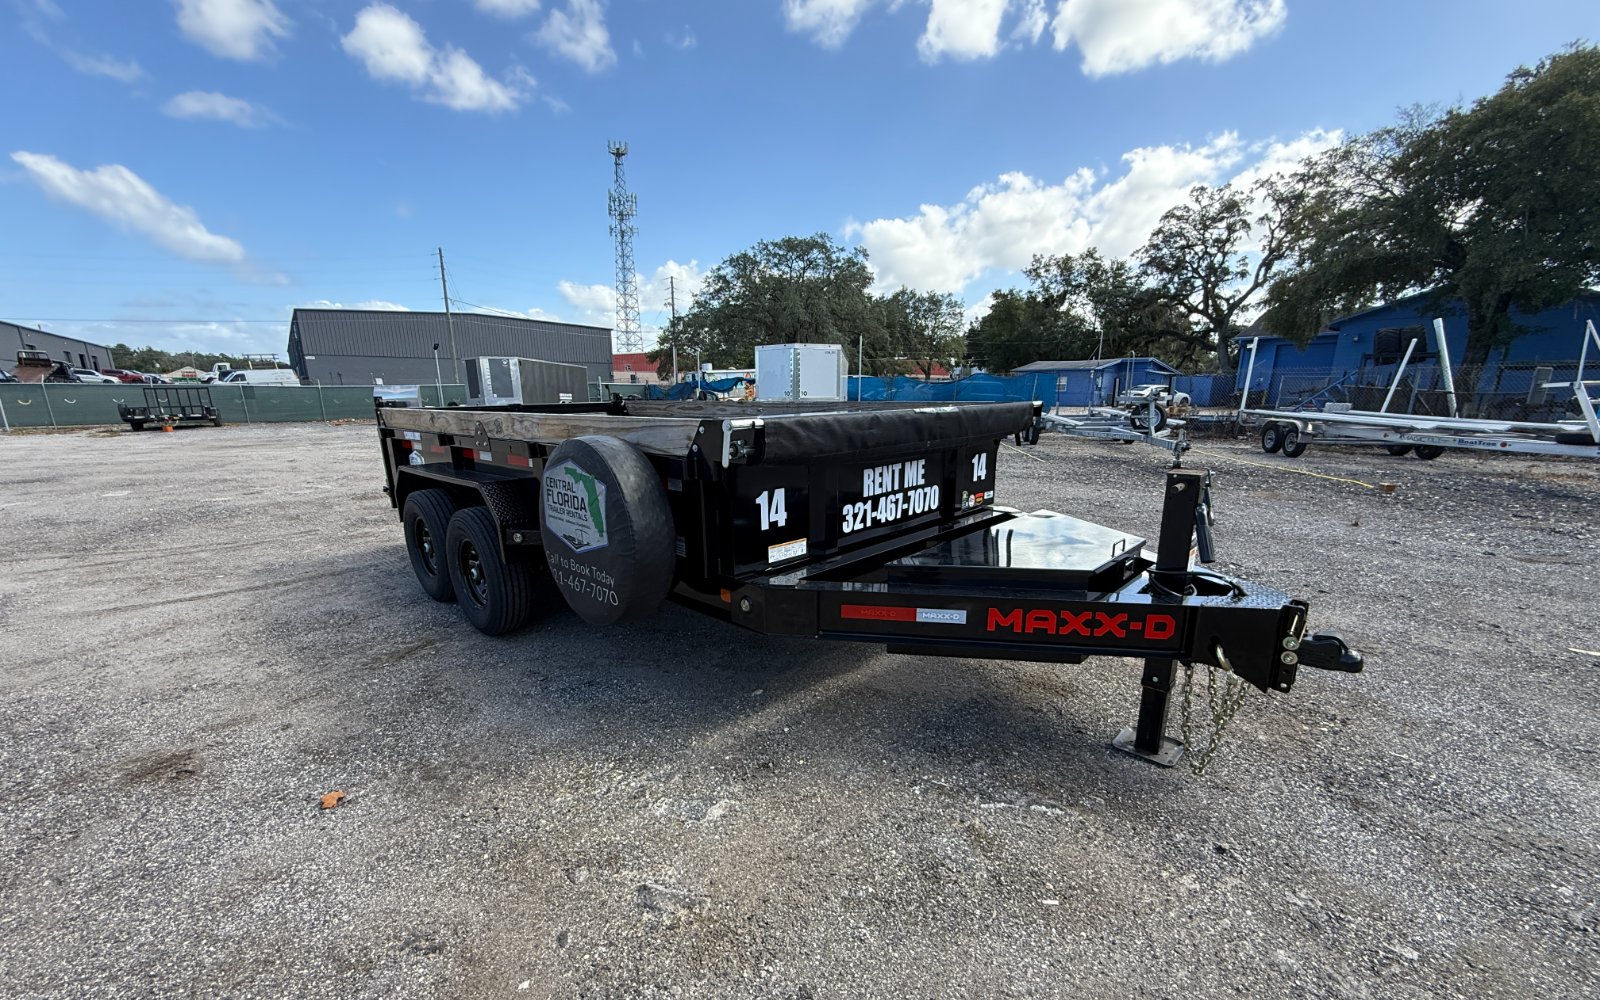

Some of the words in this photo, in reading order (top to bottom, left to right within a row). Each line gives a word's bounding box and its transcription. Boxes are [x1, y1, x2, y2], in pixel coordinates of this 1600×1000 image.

[863, 463, 902, 498] RENT
[904, 459, 926, 489] ME
[971, 452, 987, 482] 14
[546, 476, 576, 494] CENTRAL
[546, 489, 588, 514] FLORIDA
[547, 504, 566, 516] TRAILER
[566, 509, 588, 522] RENTALS
[755, 488, 788, 531] 14
[842, 485, 940, 534] 321-467-7070
[550, 567, 619, 606] 21-467-7070
[560, 556, 569, 569] to
[570, 559, 591, 577] Book
[591, 566, 615, 588] Today
[922, 611, 960, 620] MAXX-D
[986, 607, 1177, 640] MAXX-D
